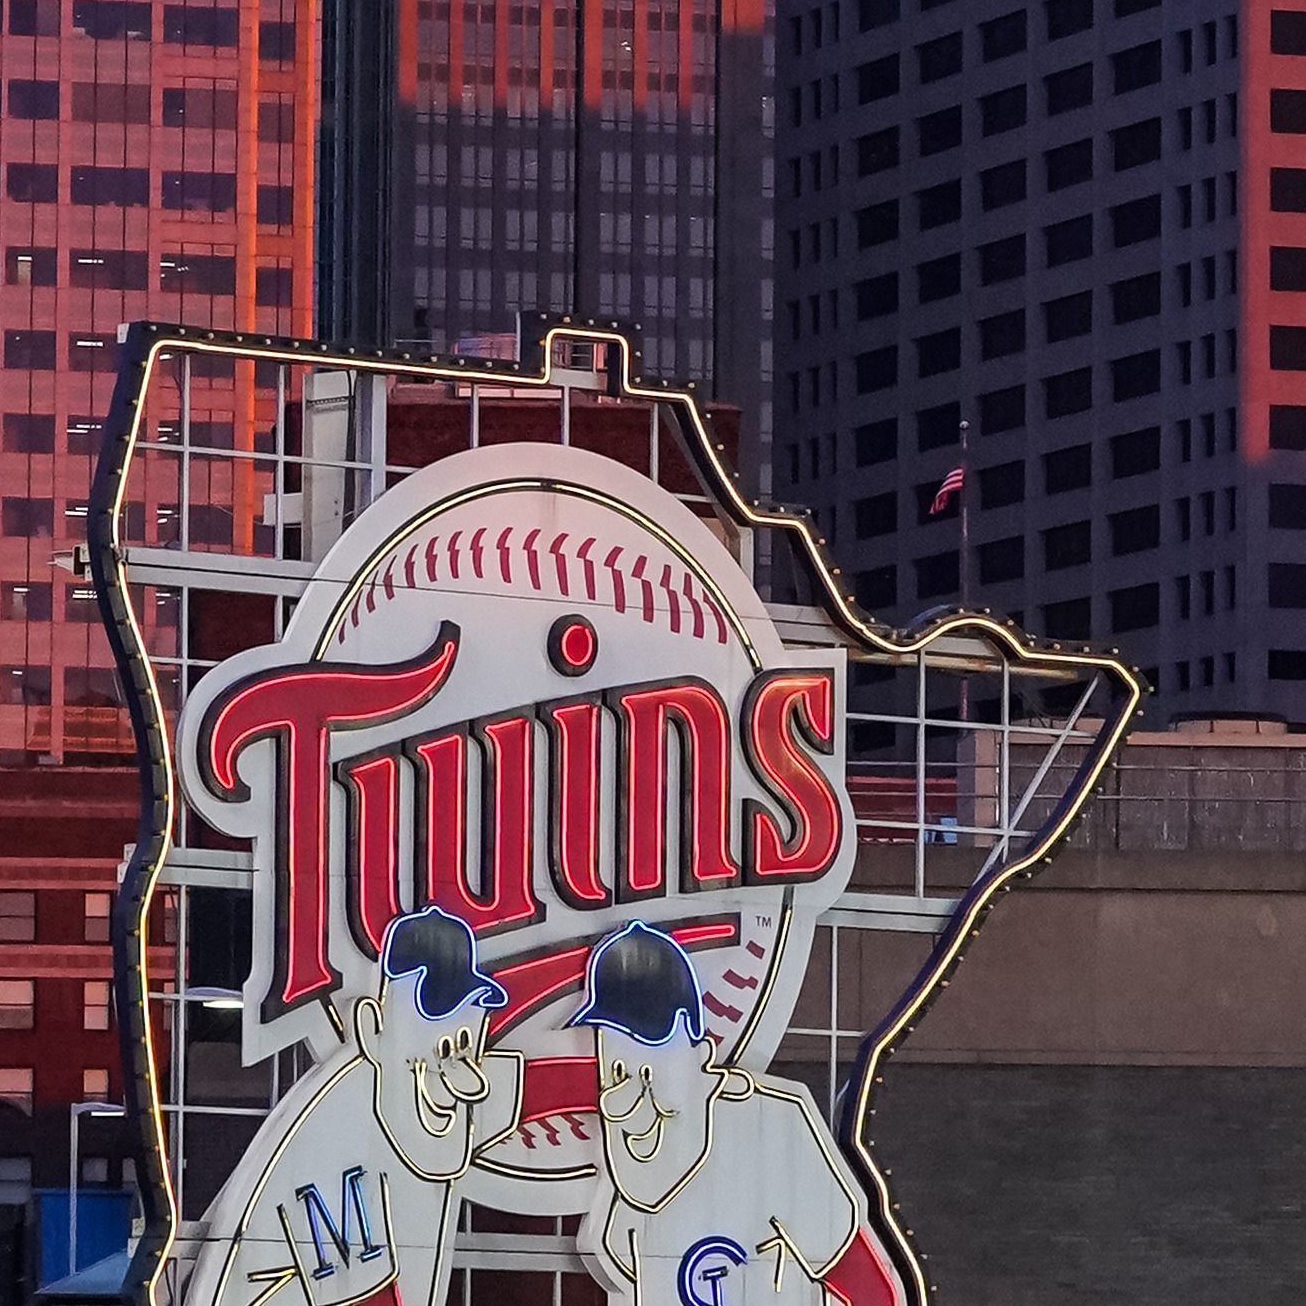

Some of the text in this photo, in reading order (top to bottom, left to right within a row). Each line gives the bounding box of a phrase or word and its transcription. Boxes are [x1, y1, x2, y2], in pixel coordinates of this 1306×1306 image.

[198, 614, 843, 1023] Twins
[755, 915, 772, 928] TM
[295, 1165, 387, 1281] M
